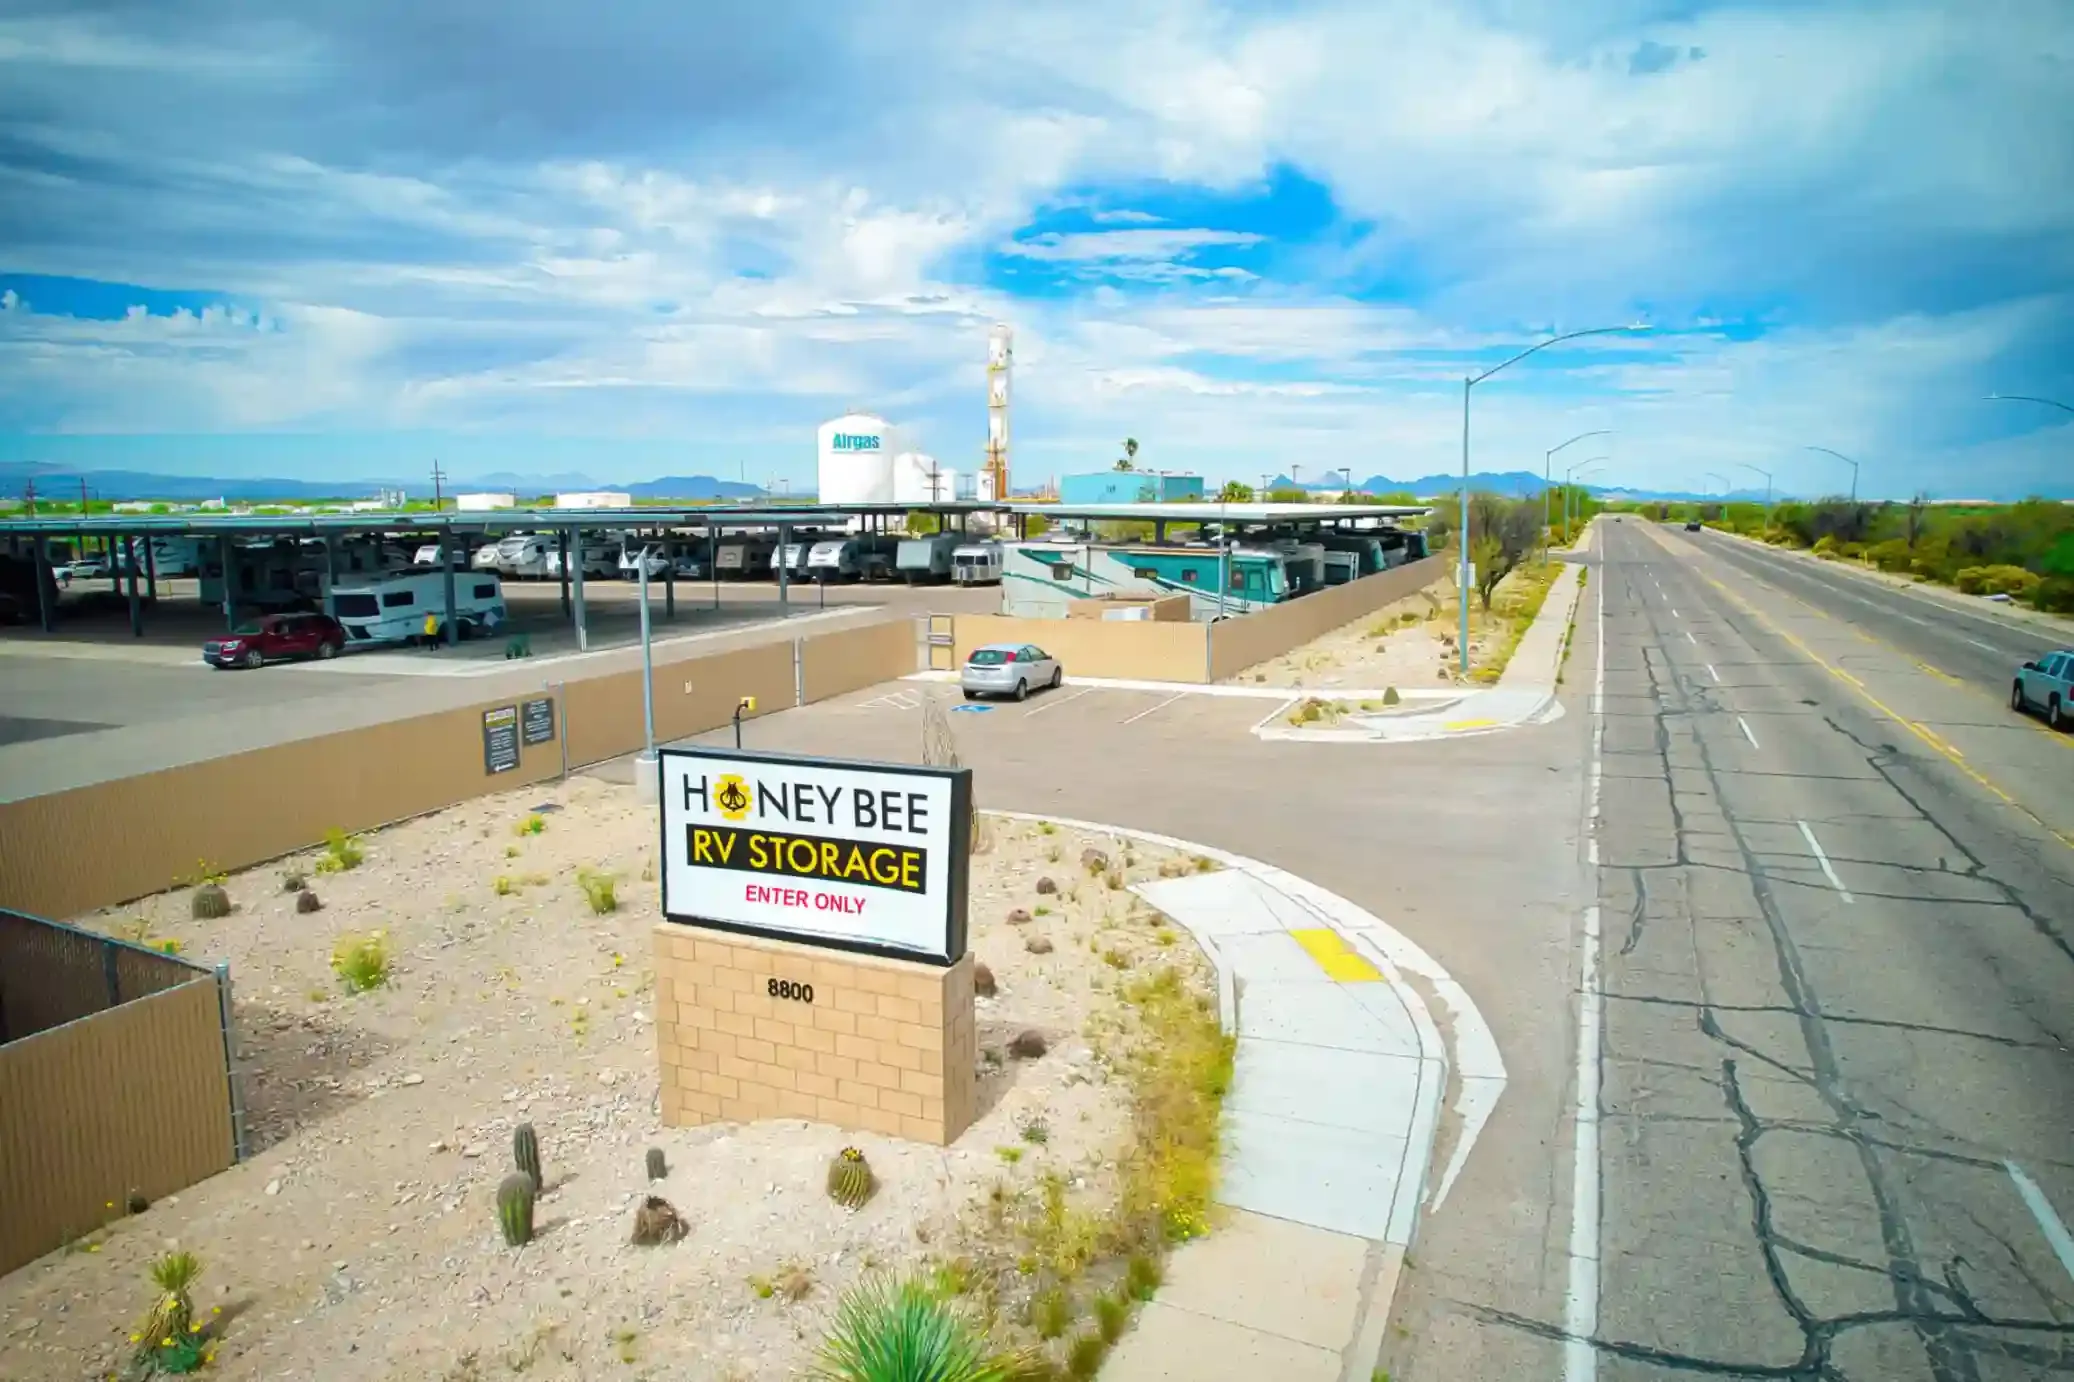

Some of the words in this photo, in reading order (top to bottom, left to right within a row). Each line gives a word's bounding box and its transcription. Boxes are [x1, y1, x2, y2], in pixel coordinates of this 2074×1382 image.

[833, 432, 880, 450] Airgas
[853, 788, 929, 835] BEE
[693, 829, 737, 864] RV
[749, 834, 920, 889] STORAGE
[745, 885, 808, 908] ENTER
[814, 893, 866, 916] ONLY
[767, 978, 813, 1004] 8800
